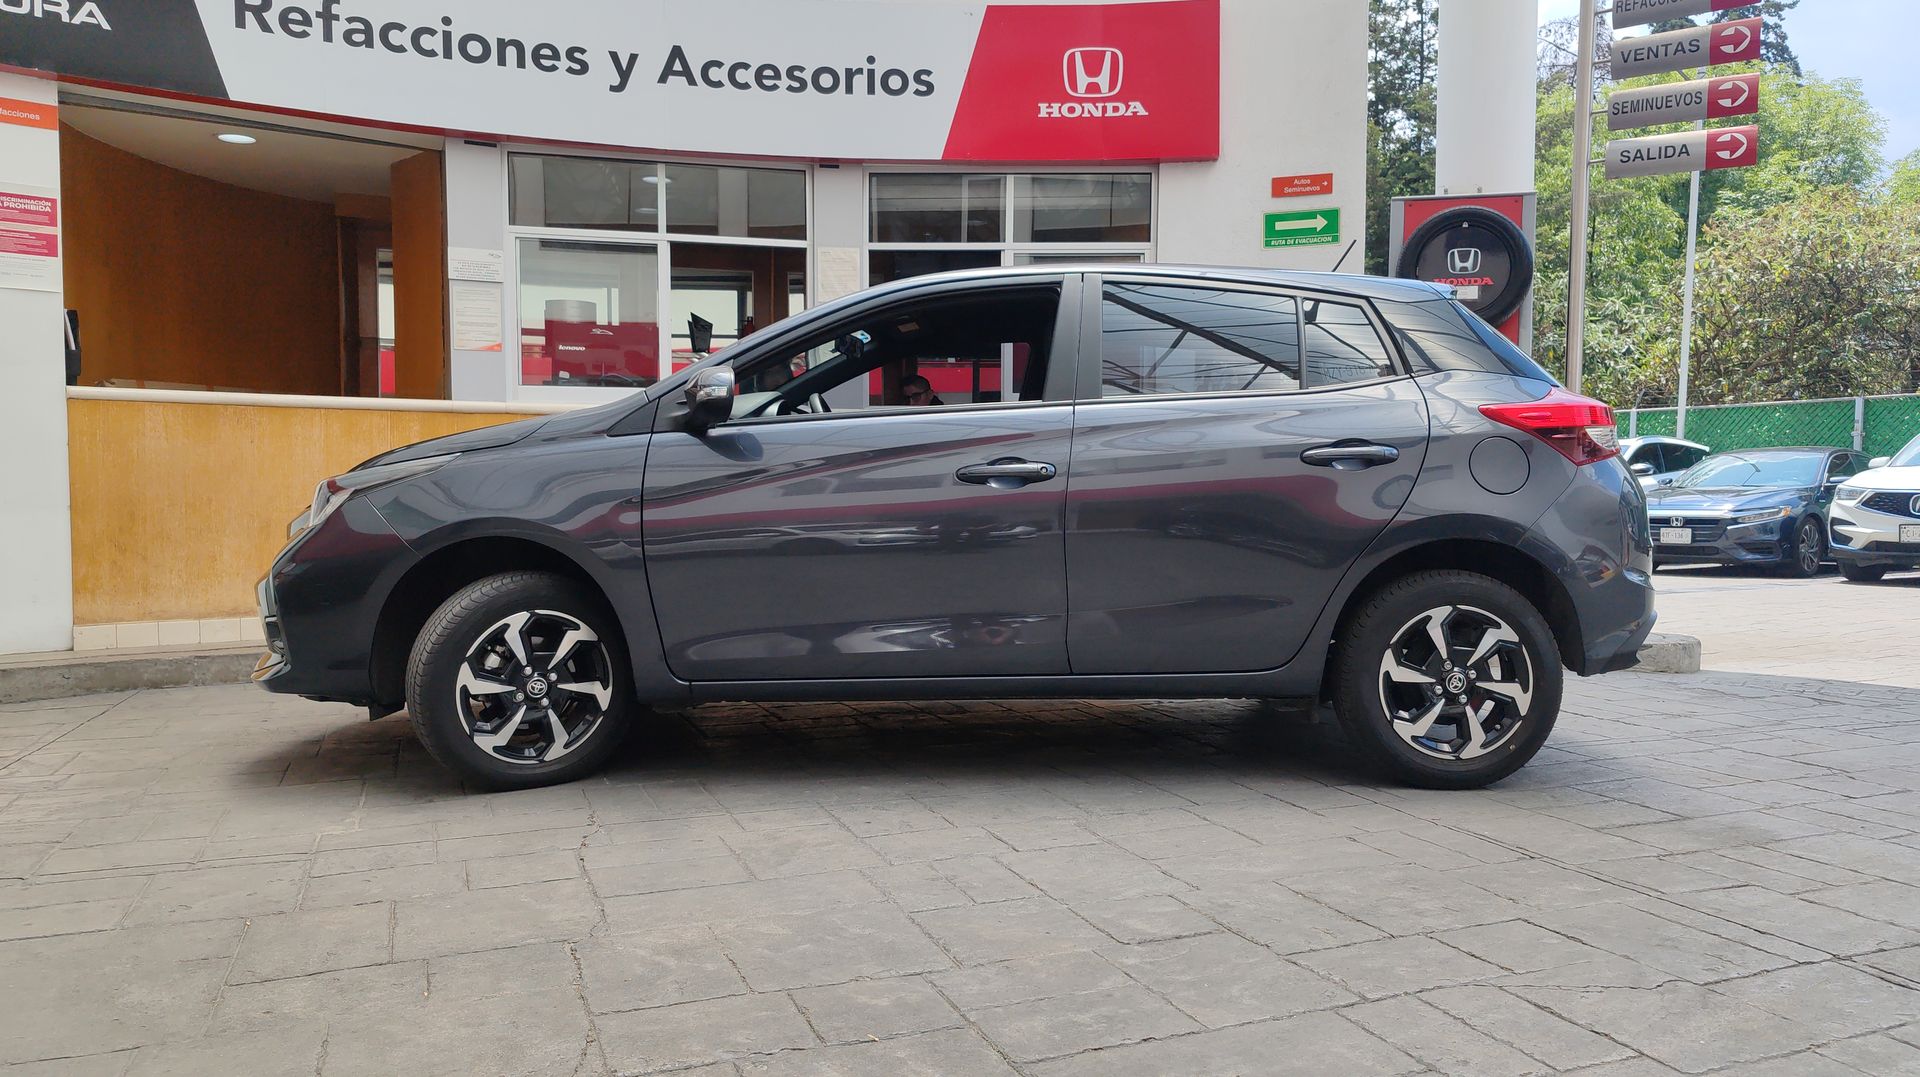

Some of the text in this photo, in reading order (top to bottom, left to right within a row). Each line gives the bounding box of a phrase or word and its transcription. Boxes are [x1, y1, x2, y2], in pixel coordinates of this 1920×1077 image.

[234, 0, 936, 98] Refacciones y Accesorios
[1620, 38, 1701, 64] VENTAS
[1037, 101, 1149, 118] HONDA
[1611, 90, 1704, 116] SEMINUEVOS
[1619, 143, 1691, 164] SALIDA
[1283, 185, 1321, 194] Seminuevos
[3, 201, 52, 213] PROHIBIDA
